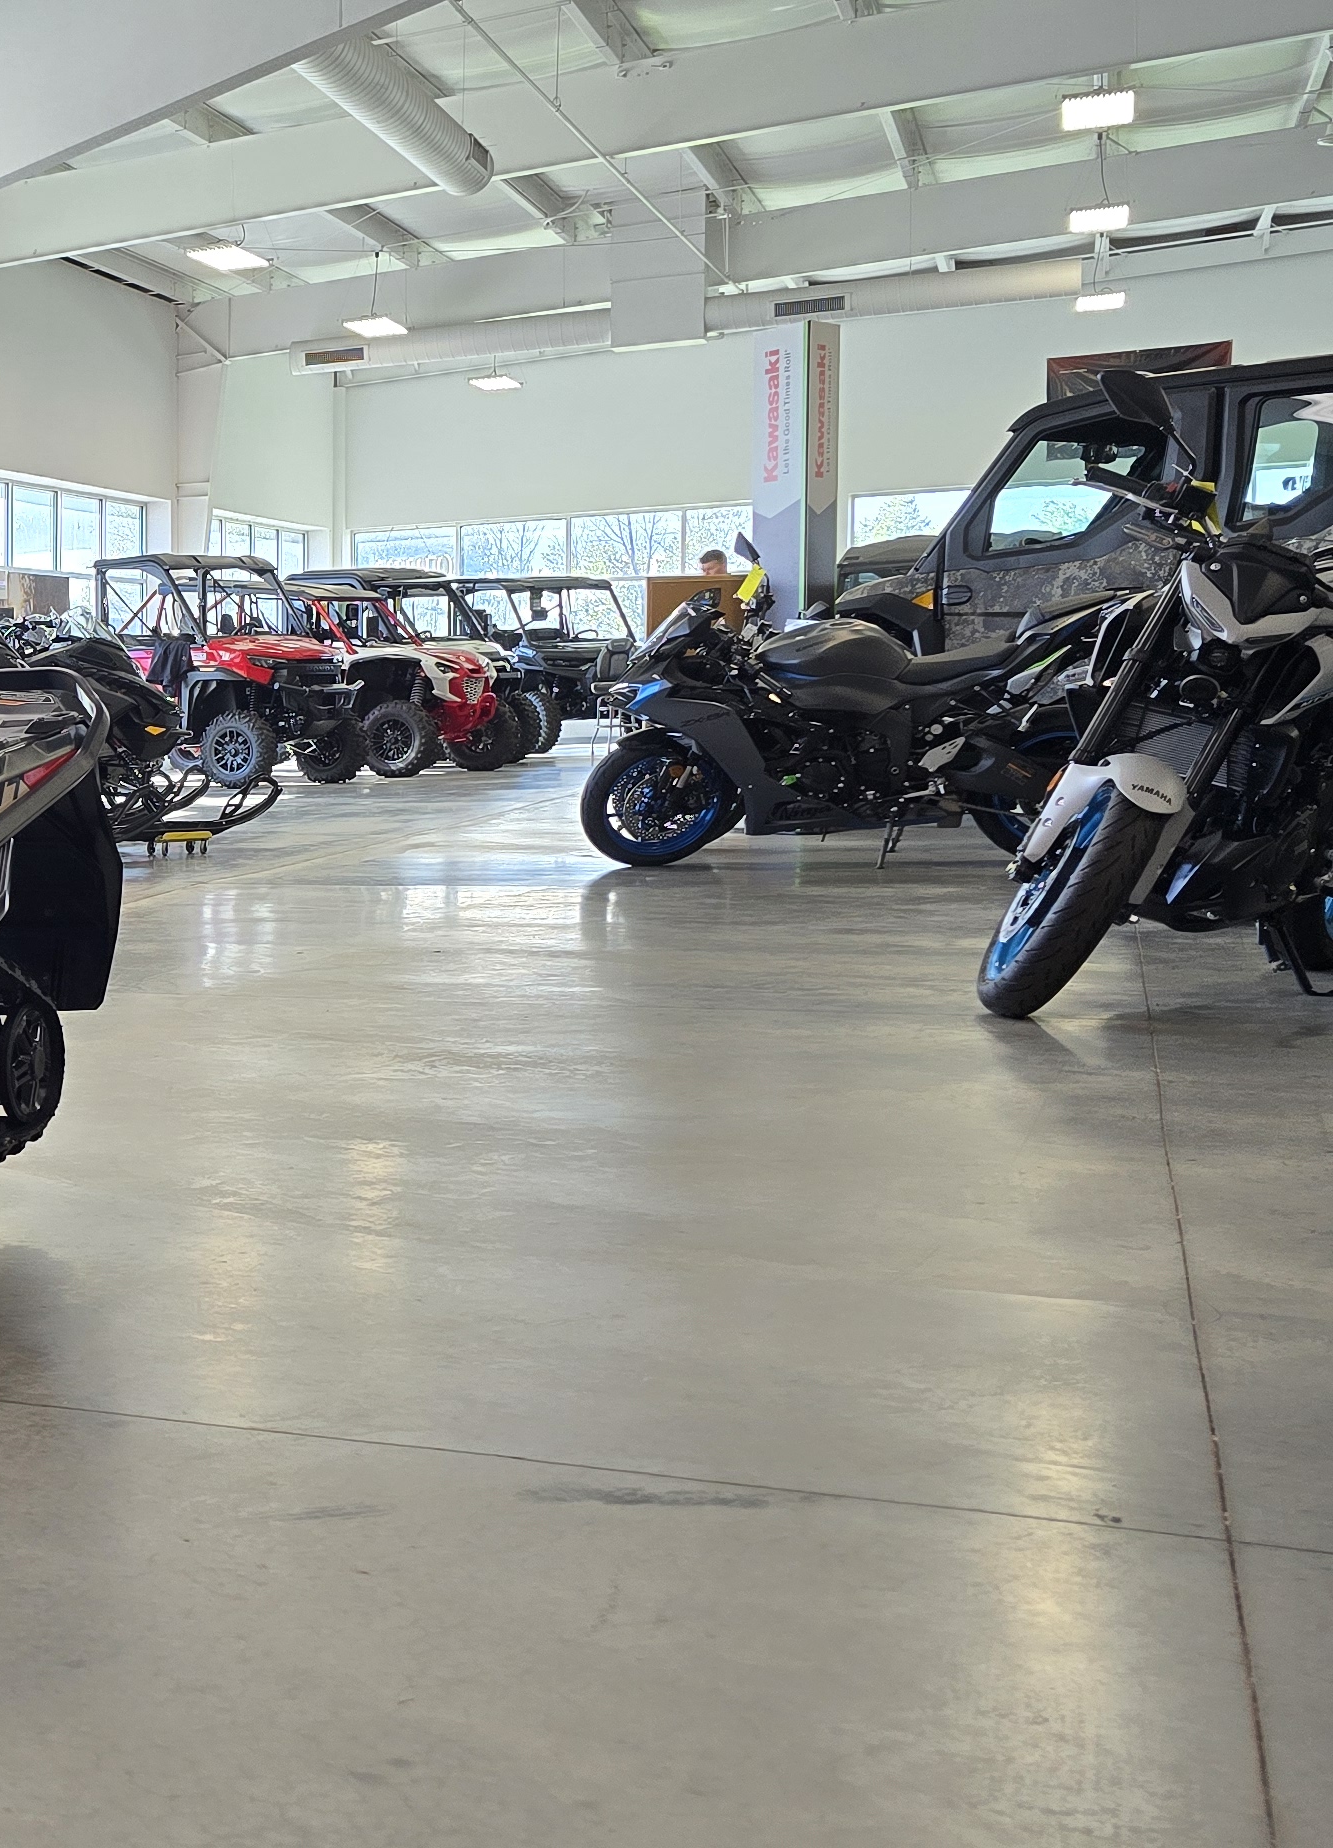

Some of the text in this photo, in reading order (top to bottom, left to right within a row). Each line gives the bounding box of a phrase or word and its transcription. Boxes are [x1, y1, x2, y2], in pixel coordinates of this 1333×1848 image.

[783, 375, 791, 407] Times
[763, 348, 780, 483] Kawasaki
[783, 408, 791, 437] Good
[814, 344, 827, 478] Kawasaki
[1131, 782, 1173, 806] YAMAHA
